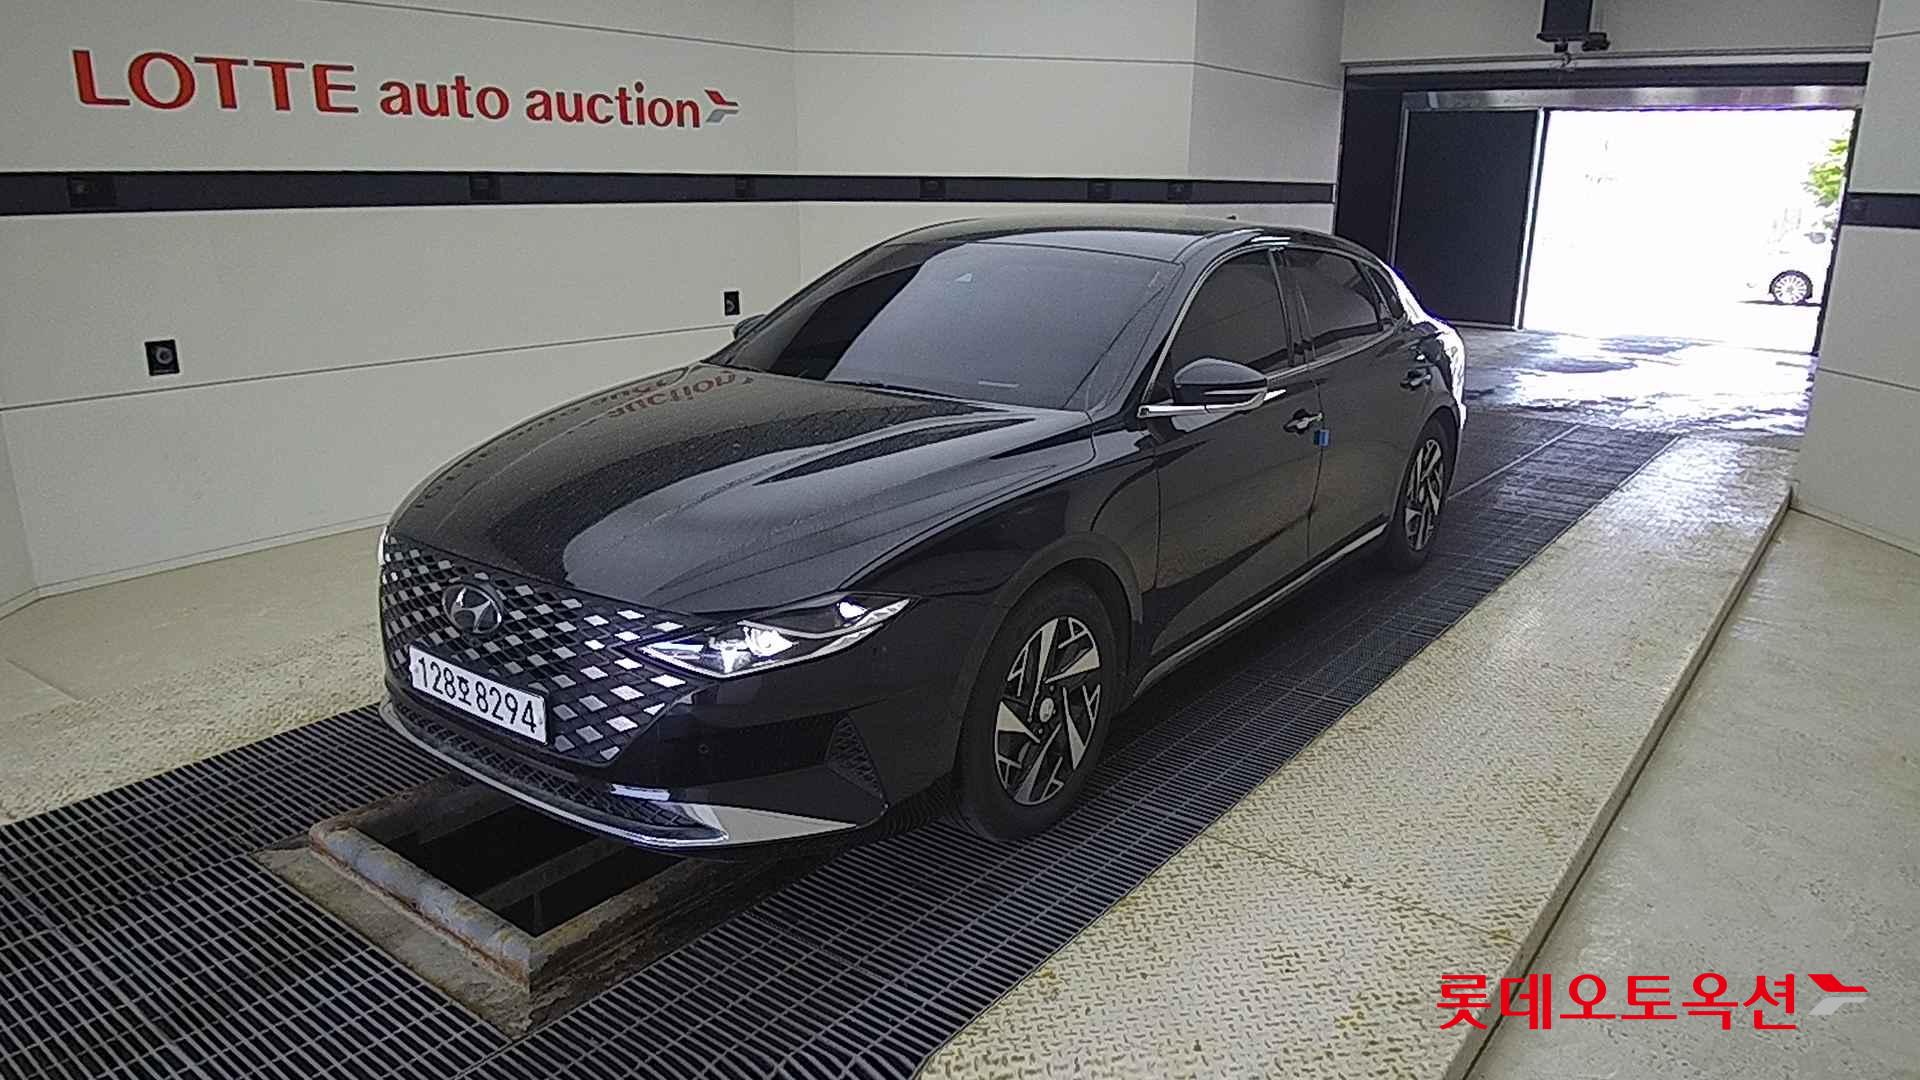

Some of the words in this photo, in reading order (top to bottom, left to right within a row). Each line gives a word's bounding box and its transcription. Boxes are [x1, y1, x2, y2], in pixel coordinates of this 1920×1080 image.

[72, 50, 358, 113] LOTTE
[380, 76, 510, 120] auto
[526, 82, 701, 128] auction
